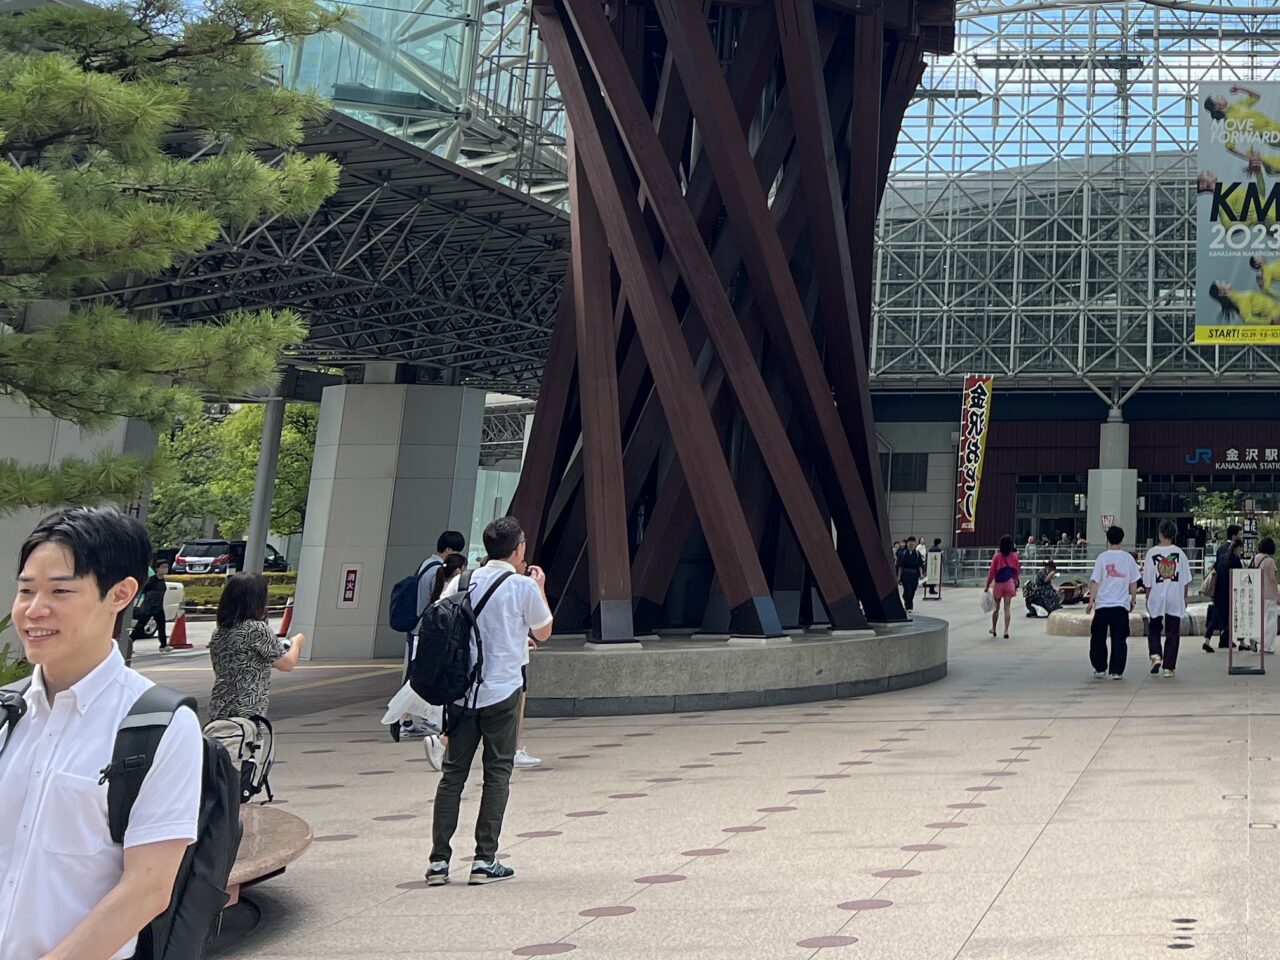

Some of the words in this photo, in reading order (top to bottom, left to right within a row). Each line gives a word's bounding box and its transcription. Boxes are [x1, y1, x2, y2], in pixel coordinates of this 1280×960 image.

[1210, 118, 1254, 131] MOVE
[1208, 329, 1240, 338] START!
[1185, 448, 1212, 464] JR
[1225, 448, 1278, 461] 金沢駅
[1215, 462, 1257, 470] KANAZAWA
